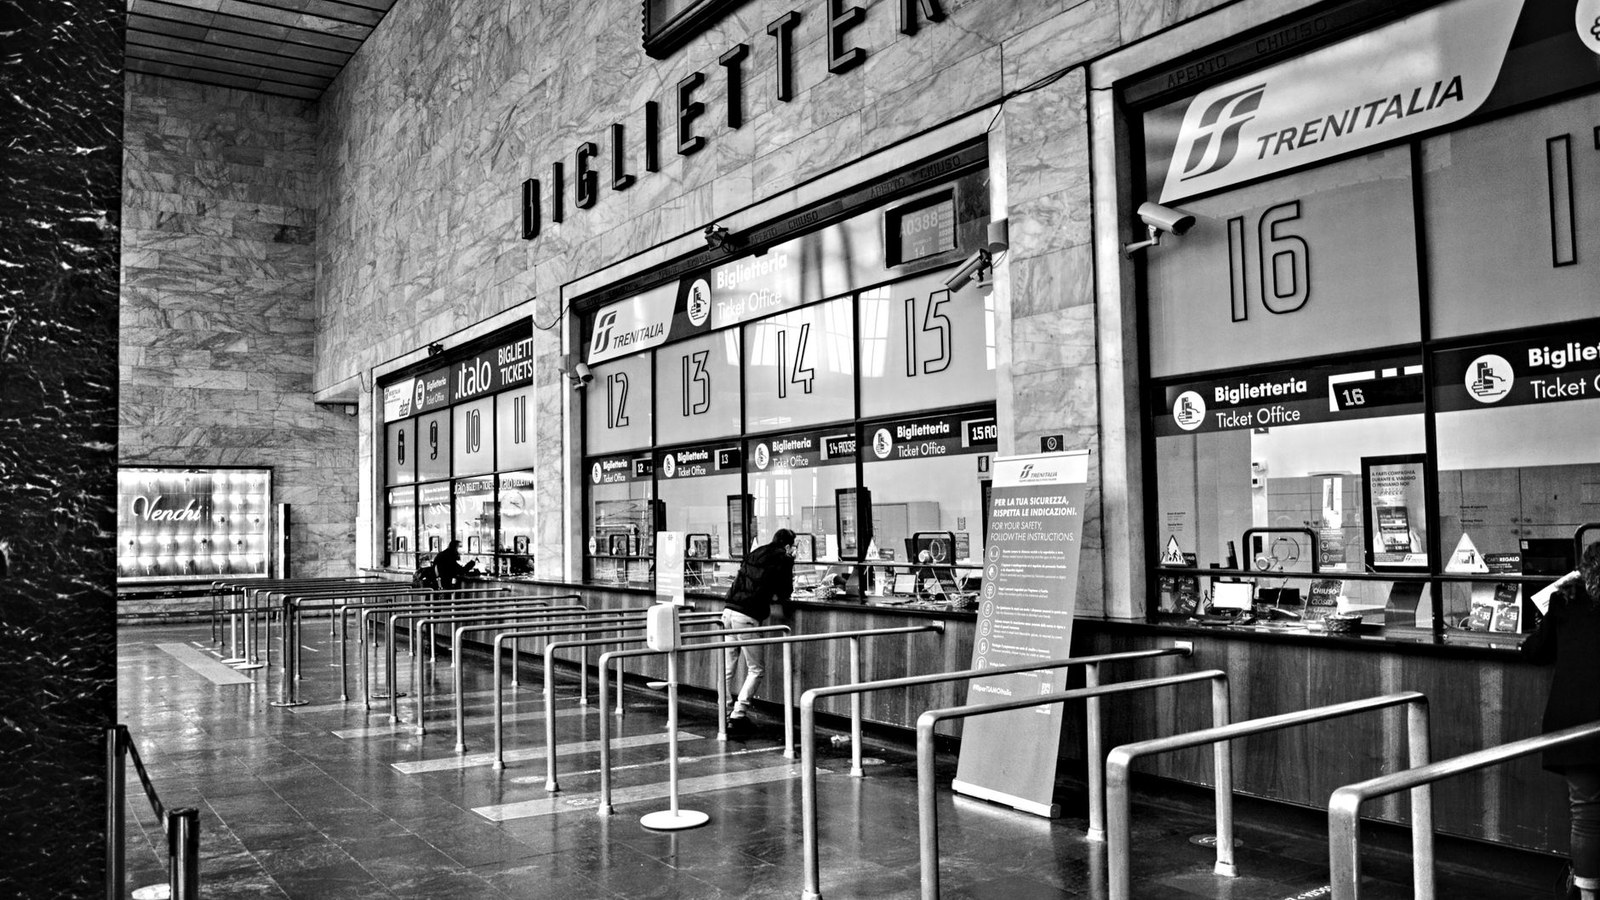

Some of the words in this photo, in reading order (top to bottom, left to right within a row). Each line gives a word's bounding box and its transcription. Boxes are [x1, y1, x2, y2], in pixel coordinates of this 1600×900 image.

[1256, 75, 1465, 161] TRENITALIA
[1546, 125, 1600, 269] 1
[717, 252, 788, 290] Biglietteria
[1227, 199, 1311, 323] 16
[717, 301, 745, 322] Ticket
[749, 288, 782, 311] Office
[613, 322, 664, 349] TRENITALIA
[905, 289, 952, 378] 15
[778, 322, 815, 399] 14
[500, 358, 533, 386] TICKETS
[426, 376, 447, 392] Biglietteria
[682, 350, 711, 417] 13
[1214, 378, 1308, 403] Biglietteria
[1530, 377, 1587, 399] Ticket
[607, 371, 630, 429] 12
[1342, 387, 1366, 407] 16
[514, 395, 526, 444] 11
[1215, 411, 1253, 429] Ticket
[1256, 407, 1301, 423] Office
[429, 420, 439, 460] 9
[466, 408, 481, 454] 10
[897, 421, 950, 441] Biglietteria
[398, 428, 405, 466] 8
[772, 437, 812, 453] Biglietteria
[897, 445, 919, 459] Ticket
[920, 442, 946, 457] Office
[603, 458, 628, 472] Biglietteria
[677, 449, 709, 464] Biglietteria
[721, 455, 729, 465] 13
[772, 457, 788, 469] Ticket
[789, 454, 810, 467] Office
[603, 473, 614, 483] Ticket
[614, 472, 626, 482] Office
[637, 463, 644, 473] 12
[677, 466, 691, 478] Ticket
[691, 463, 707, 476] Office
[132, 495, 202, 521] Venchi
[993, 508, 1020, 517] RISPETTA
[1021, 508, 1029, 517] LE
[1030, 507, 1077, 516] INDICAZIONI.
[994, 498, 1006, 507] PER
[1007, 498, 1015, 506] LA
[1015, 497, 1028, 506] TUA
[1030, 496, 1069, 506] SICUREZZA,
[990, 533, 1015, 541] FOLLOW
[1015, 532, 1026, 541] THE
[1027, 532, 1074, 541] INSTRUCTIONS.
[991, 522, 1003, 531] FOR
[1004, 521, 1020, 531] YOUR
[1021, 521, 1042, 531] SAFETY,
[1312, 587, 1338, 595] CHIUSO
